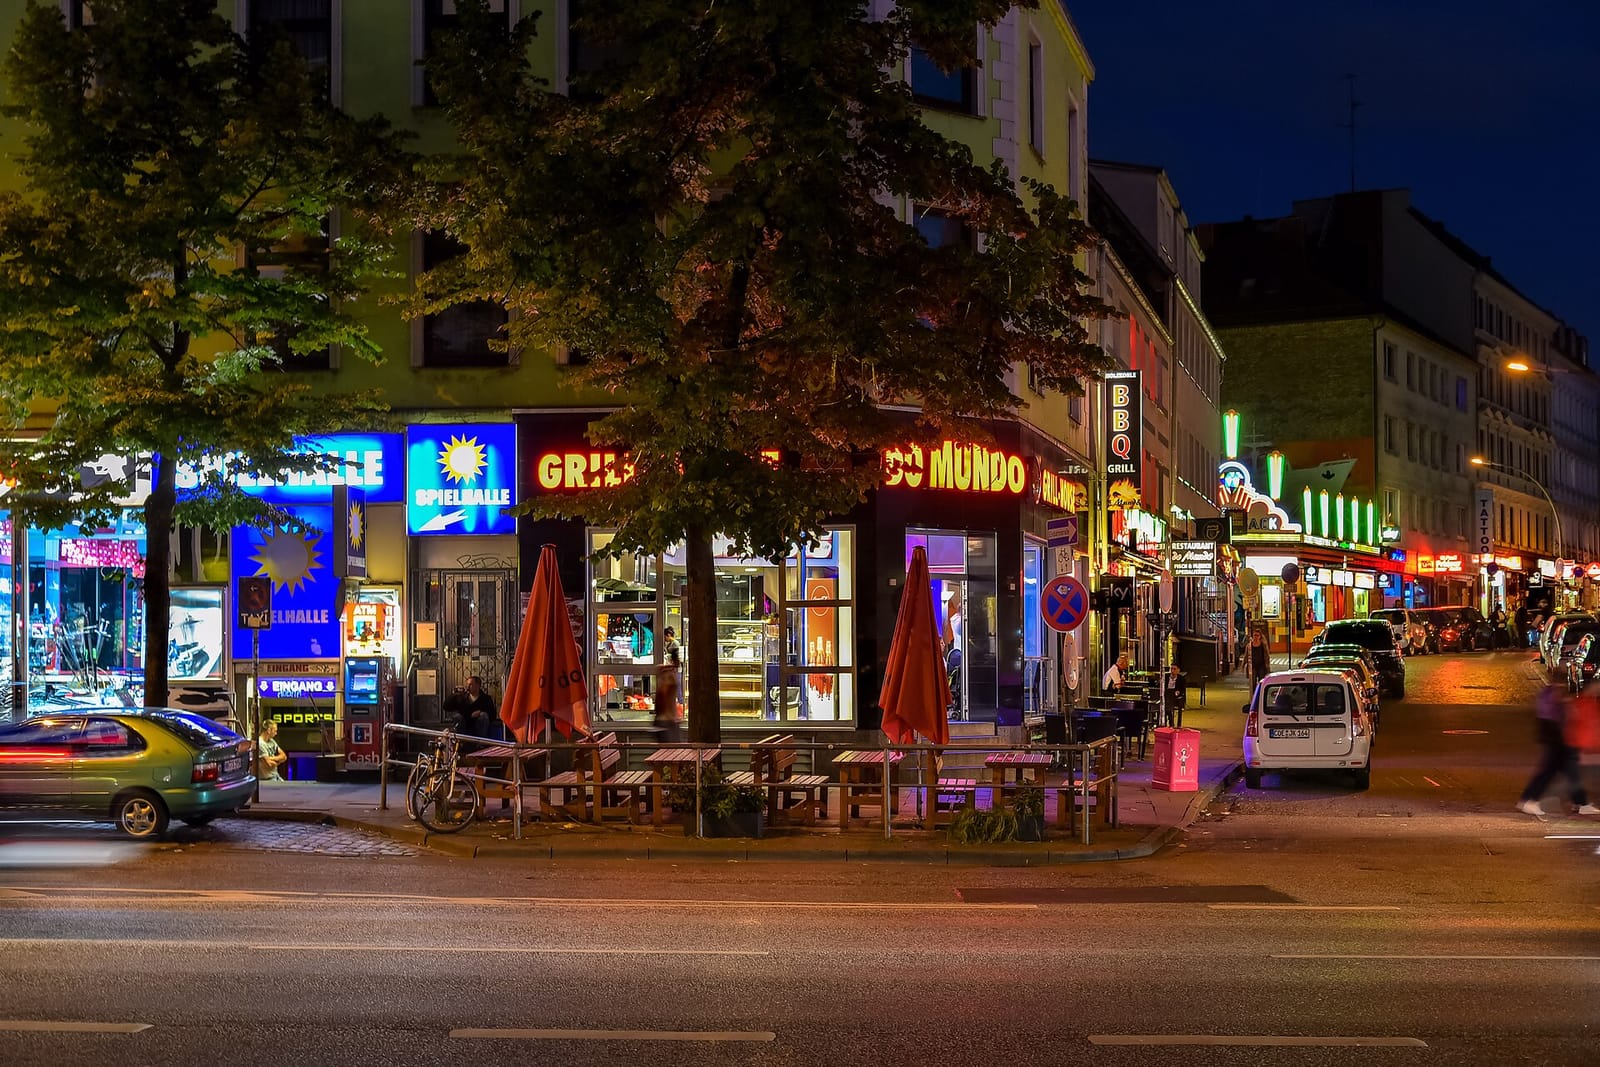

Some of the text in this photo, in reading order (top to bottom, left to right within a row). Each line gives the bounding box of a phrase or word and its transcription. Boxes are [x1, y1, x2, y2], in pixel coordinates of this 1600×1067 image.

[1112, 384, 1130, 460] BBQ
[929, 440, 1025, 494] MUNDO
[1107, 463, 1136, 474] GRILL
[415, 488, 510, 506] SPIELHALLE
[1480, 499, 1490, 554] TATTOO
[1171, 542, 1214, 550] RESTAURANT
[353, 605, 377, 616] ATM
[240, 609, 270, 626] TXI
[267, 664, 309, 673] EINGANG
[272, 680, 323, 692] EINGANG
[272, 713, 337, 724] SPORTS
[348, 751, 380, 764] Cash
